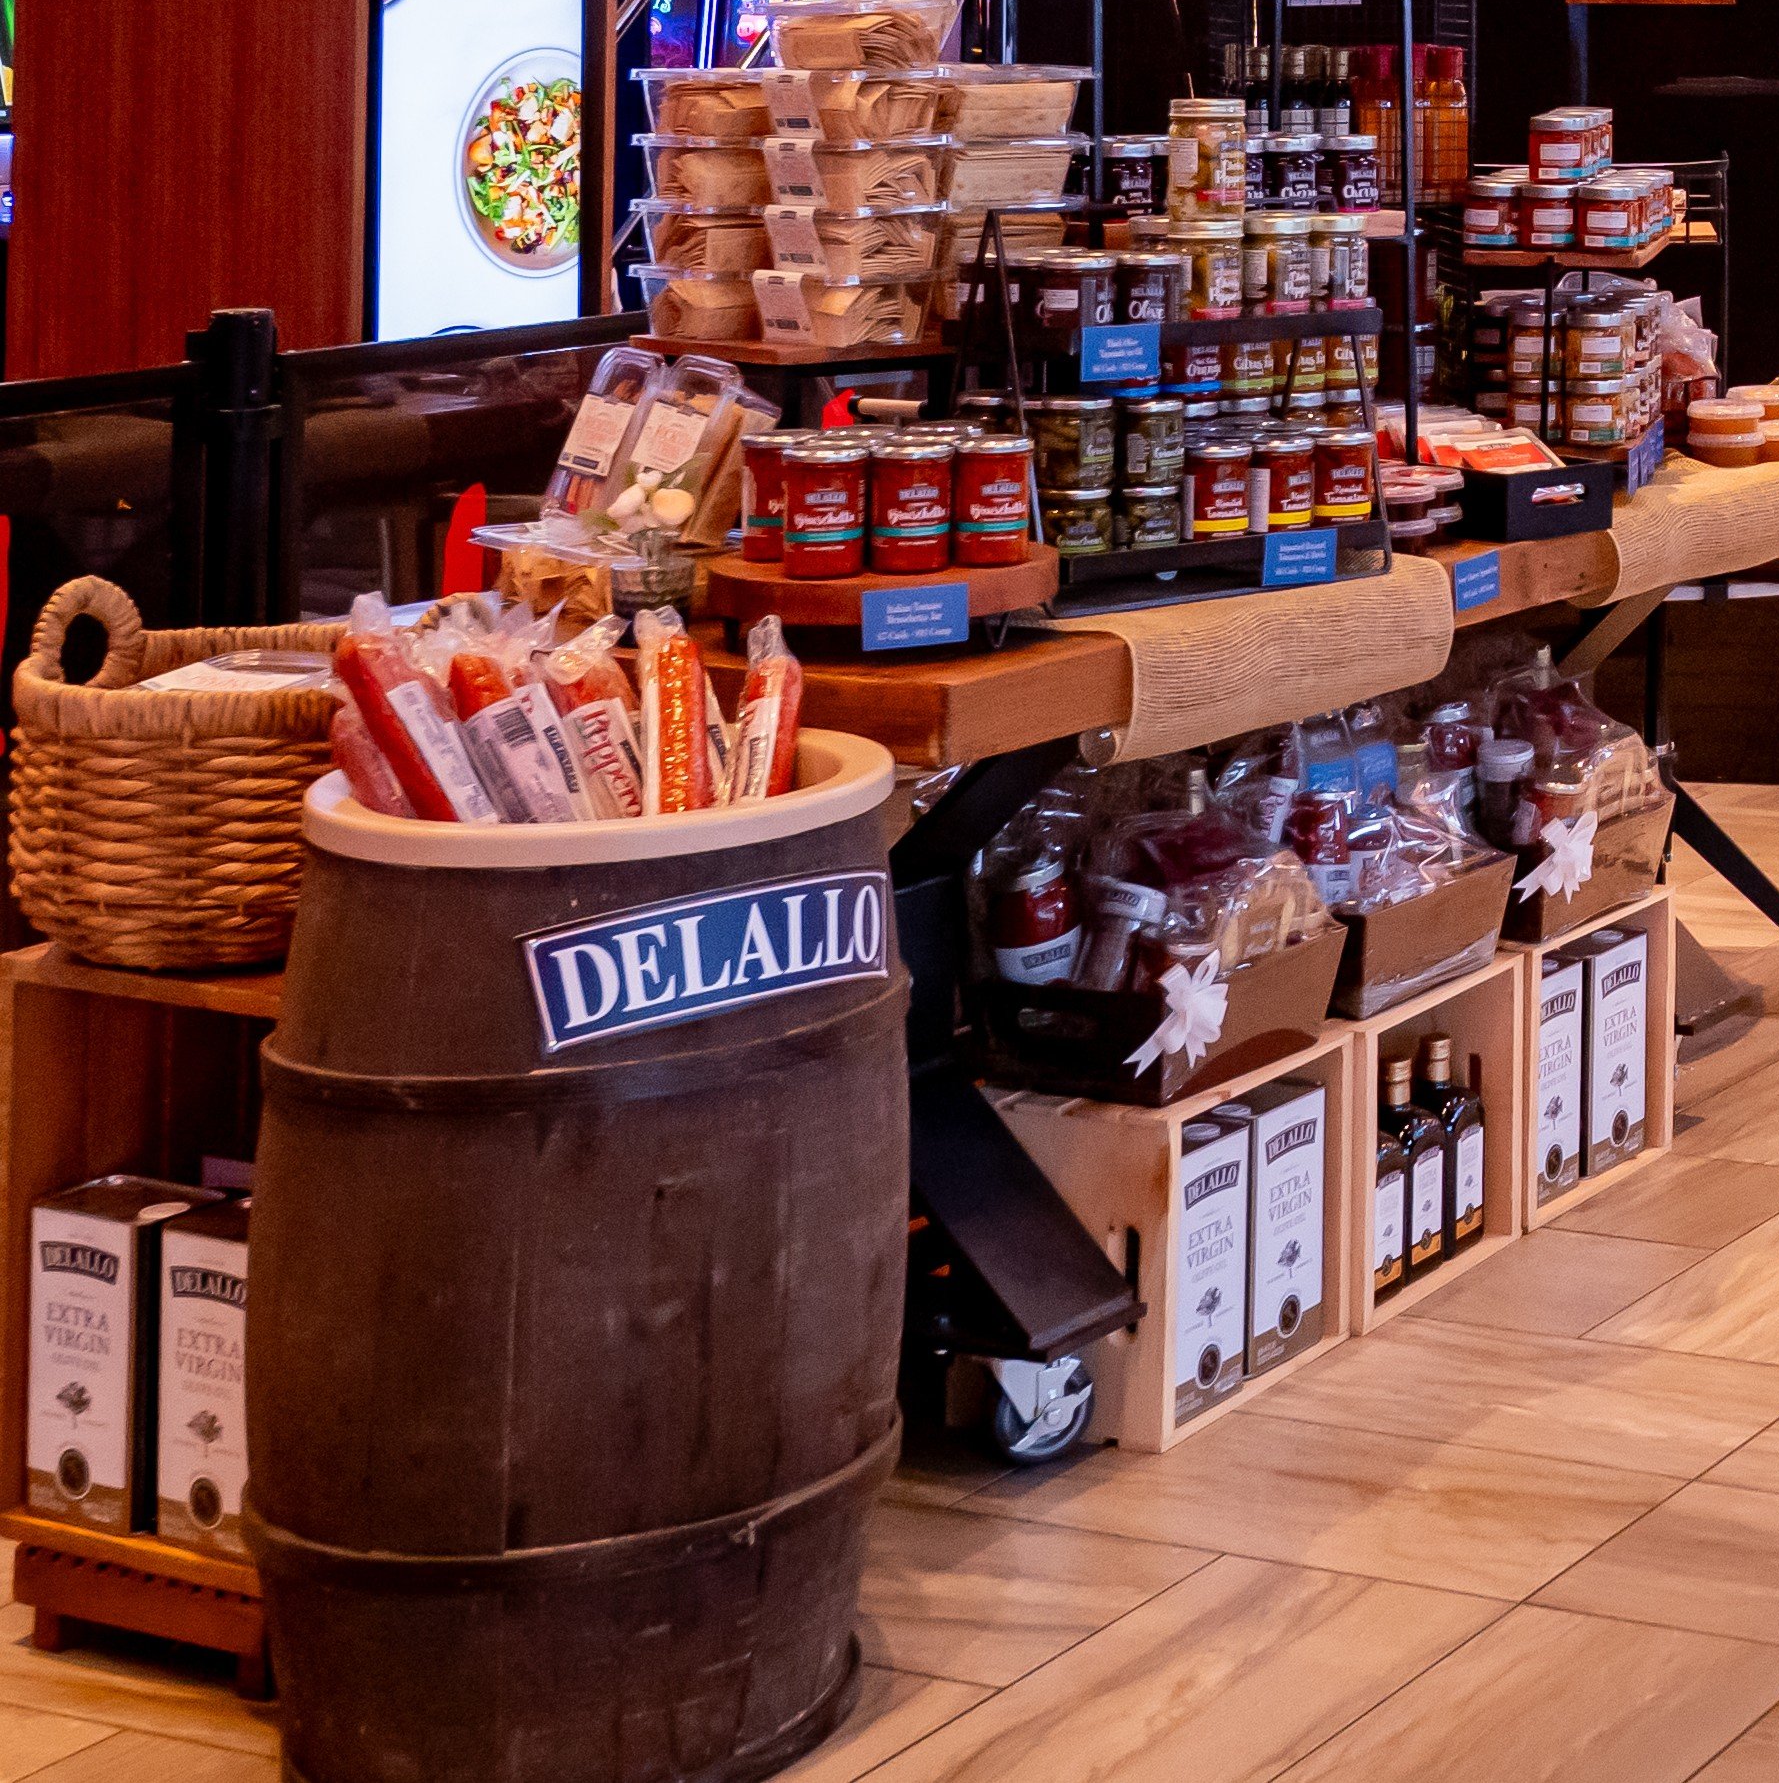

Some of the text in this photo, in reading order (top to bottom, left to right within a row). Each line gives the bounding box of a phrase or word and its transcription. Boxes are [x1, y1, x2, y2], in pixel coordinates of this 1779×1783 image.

[550, 884, 881, 1030] DELALLO
[1603, 963, 1640, 994] DELALLO
[1603, 1020, 1638, 1047] VIRGIN
[1604, 1006, 1637, 1032] EXTRA
[1268, 1122, 1315, 1161] DELALLO
[1187, 1165, 1237, 1203] DELALLO
[1269, 1169, 1311, 1204] EXTRA
[1268, 1188, 1313, 1222] VIRGIN
[1188, 1214, 1233, 1250] EXTRA
[1187, 1233, 1234, 1270] VIRGIN
[47, 1301, 110, 1333] EXTRA
[44, 1324, 111, 1356] VIRGIN
[177, 1327, 241, 1360] EXTRA
